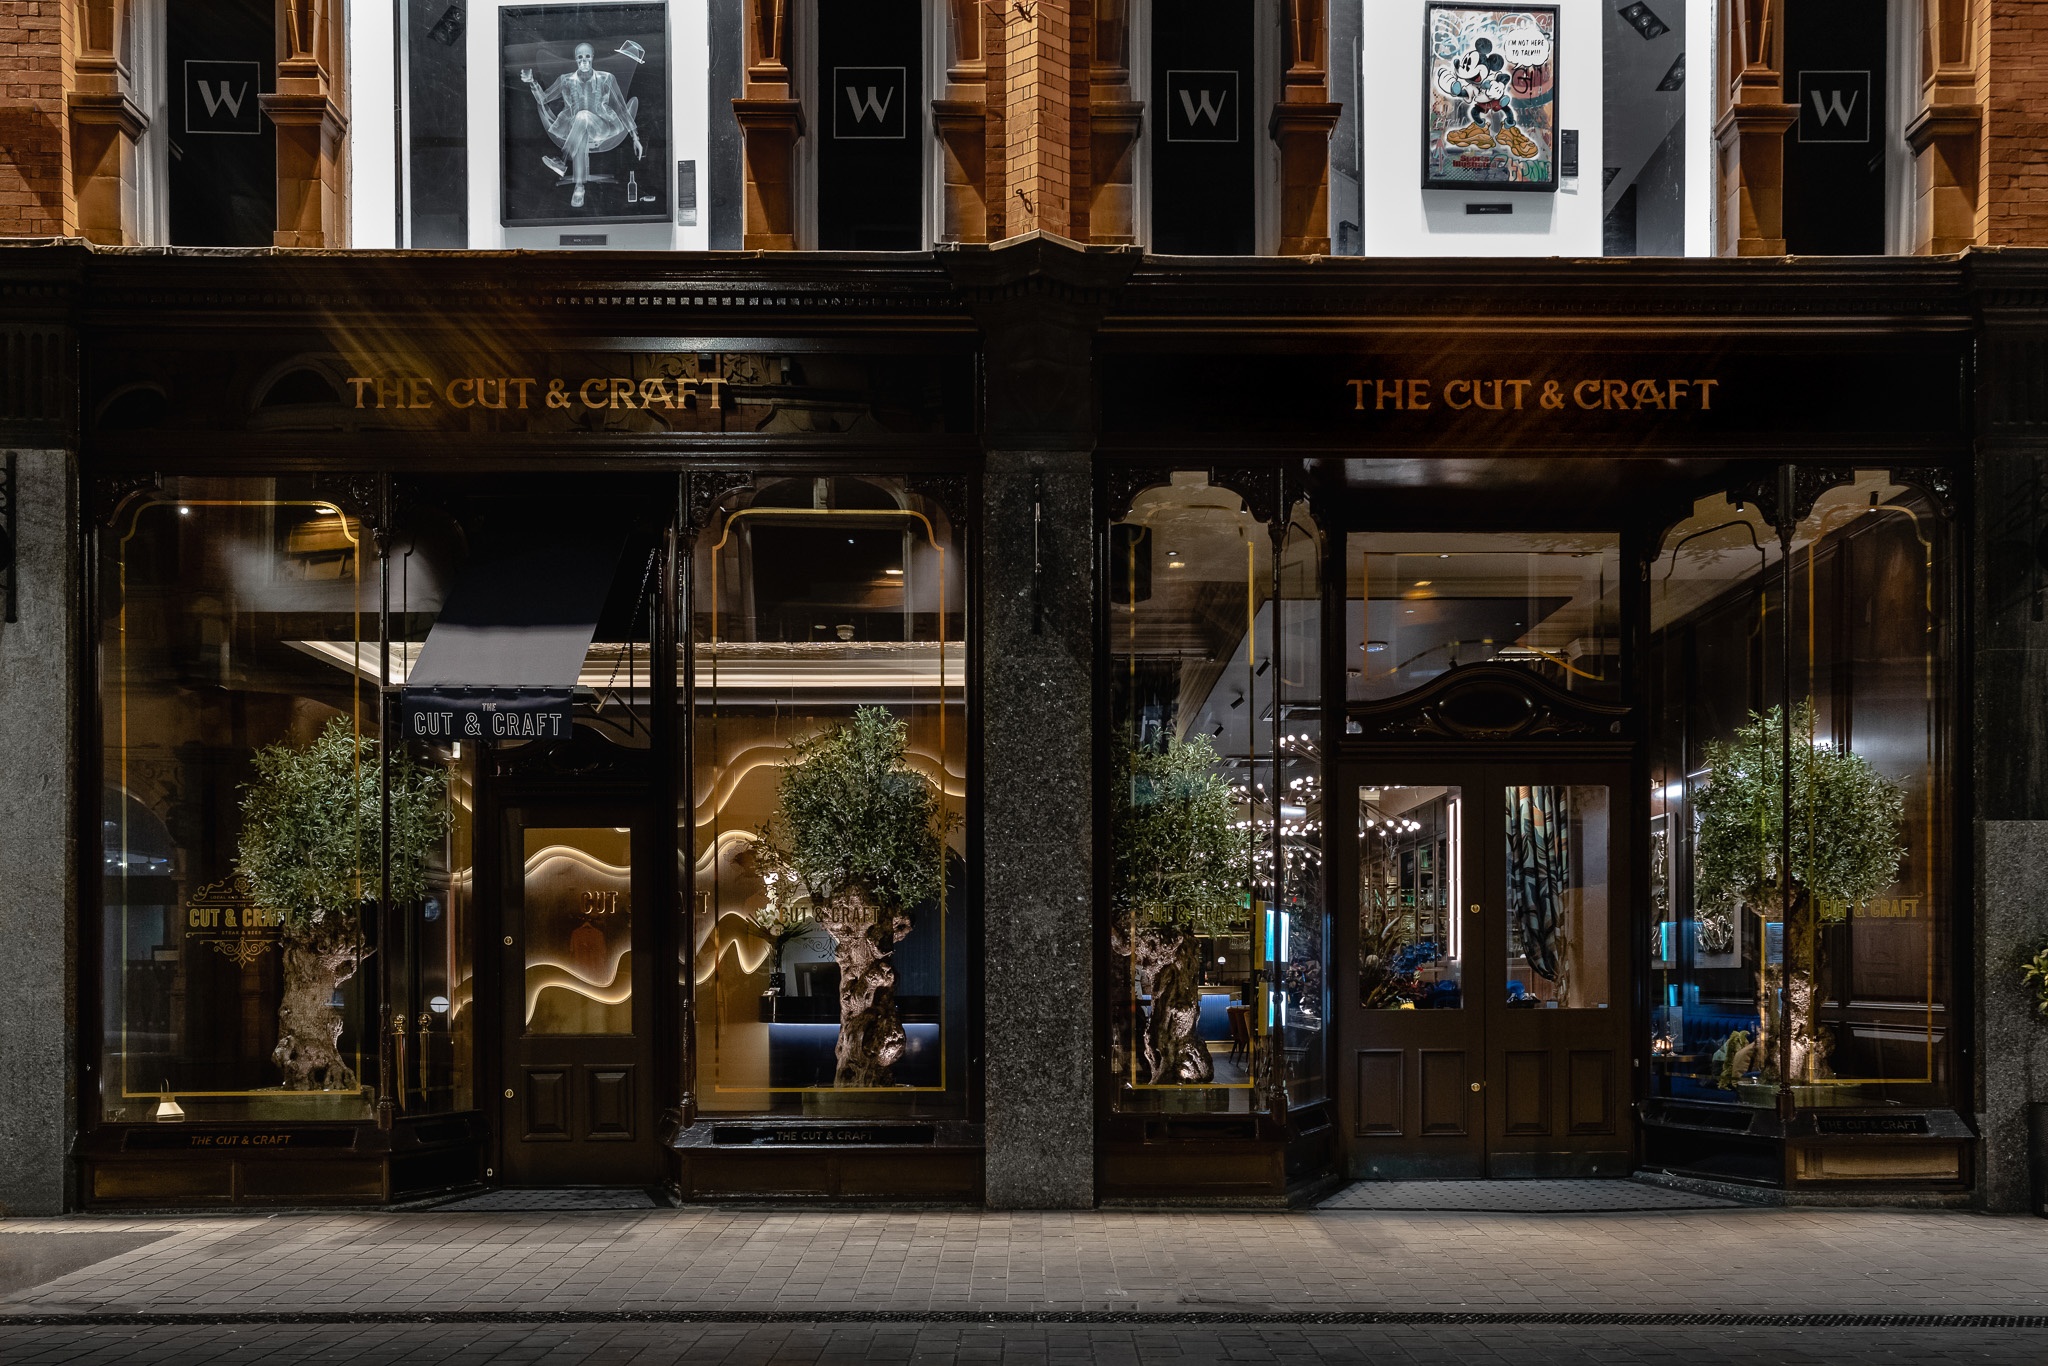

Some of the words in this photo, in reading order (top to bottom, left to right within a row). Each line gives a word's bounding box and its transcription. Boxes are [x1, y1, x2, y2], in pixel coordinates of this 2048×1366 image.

[1518, 39, 1529, 47] NOT
[1530, 39, 1545, 47] HERE
[1512, 49, 1520, 57] TO
[197, 80, 248, 118] W
[845, 86, 894, 123] W
[1178, 89, 1227, 127] W
[1810, 90, 1859, 127] W
[346, 377, 433, 409] THE
[445, 377, 537, 409] CUT
[545, 378, 571, 409] &
[580, 377, 729, 409] CRAFT
[1346, 379, 1431, 410] THE
[1443, 379, 1532, 410] CUT
[1539, 379, 1565, 410] &
[1573, 379, 1719, 410] CRAFT
[482, 702, 496, 711] THE
[413, 712, 453, 736] CUT
[464, 712, 482, 736] &
[492, 712, 562, 736] CRAFT
[581, 891, 619, 914] CUT
[1820, 900, 1849, 918] CUT
[1870, 900, 1919, 918] CRAFT
[189, 908, 220, 928] CUT
[224, 908, 237, 928] &
[242, 908, 293, 928] CRAFT
[779, 907, 808, 924] CUT
[814, 906, 825, 924] &
[831, 906, 881, 924] CRAFT
[1142, 904, 1173, 922] CUT
[1177, 904, 1188, 922] &
[1194, 904, 1244, 922] CRAFT
[1822, 1119, 1843, 1130] THE
[1846, 1120, 1867, 1130] CUT
[1880, 1120, 1918, 1130] CRAFT
[191, 1135, 213, 1146] THE
[216, 1135, 239, 1146] CUT
[241, 1135, 249, 1146] &
[252, 1135, 290, 1146] CRAFT
[776, 1130, 798, 1141] THE
[801, 1130, 823, 1141] CUT
[825, 1130, 835, 1141] &
[836, 1130, 872, 1141] CRAFT
